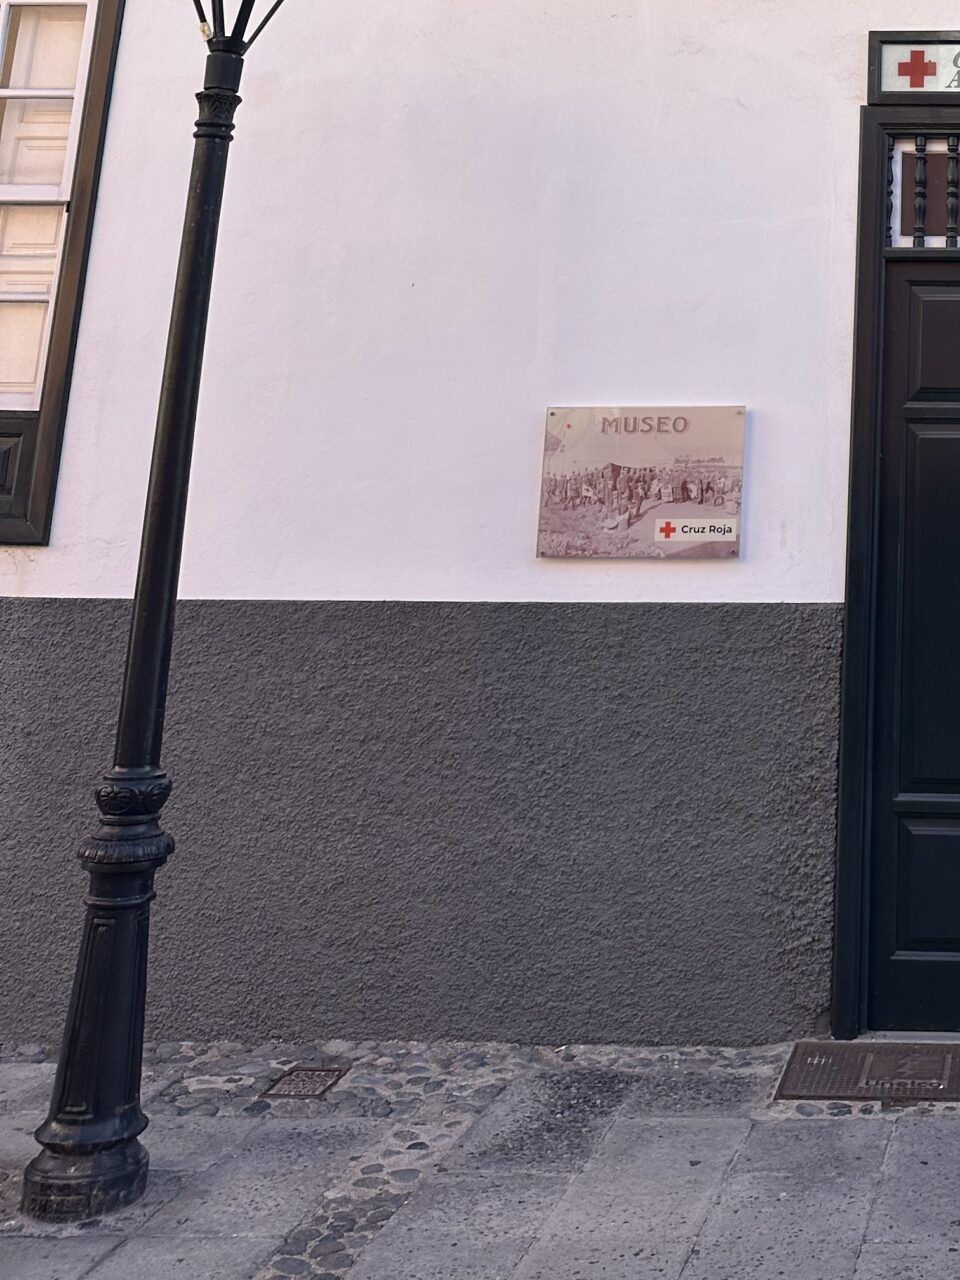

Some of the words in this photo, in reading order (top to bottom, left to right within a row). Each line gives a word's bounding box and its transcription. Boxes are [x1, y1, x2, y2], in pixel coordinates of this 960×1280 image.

[601, 416, 690, 434] MUSEO
[681, 524, 706, 534] Cruz
[709, 524, 733, 535] Roja
